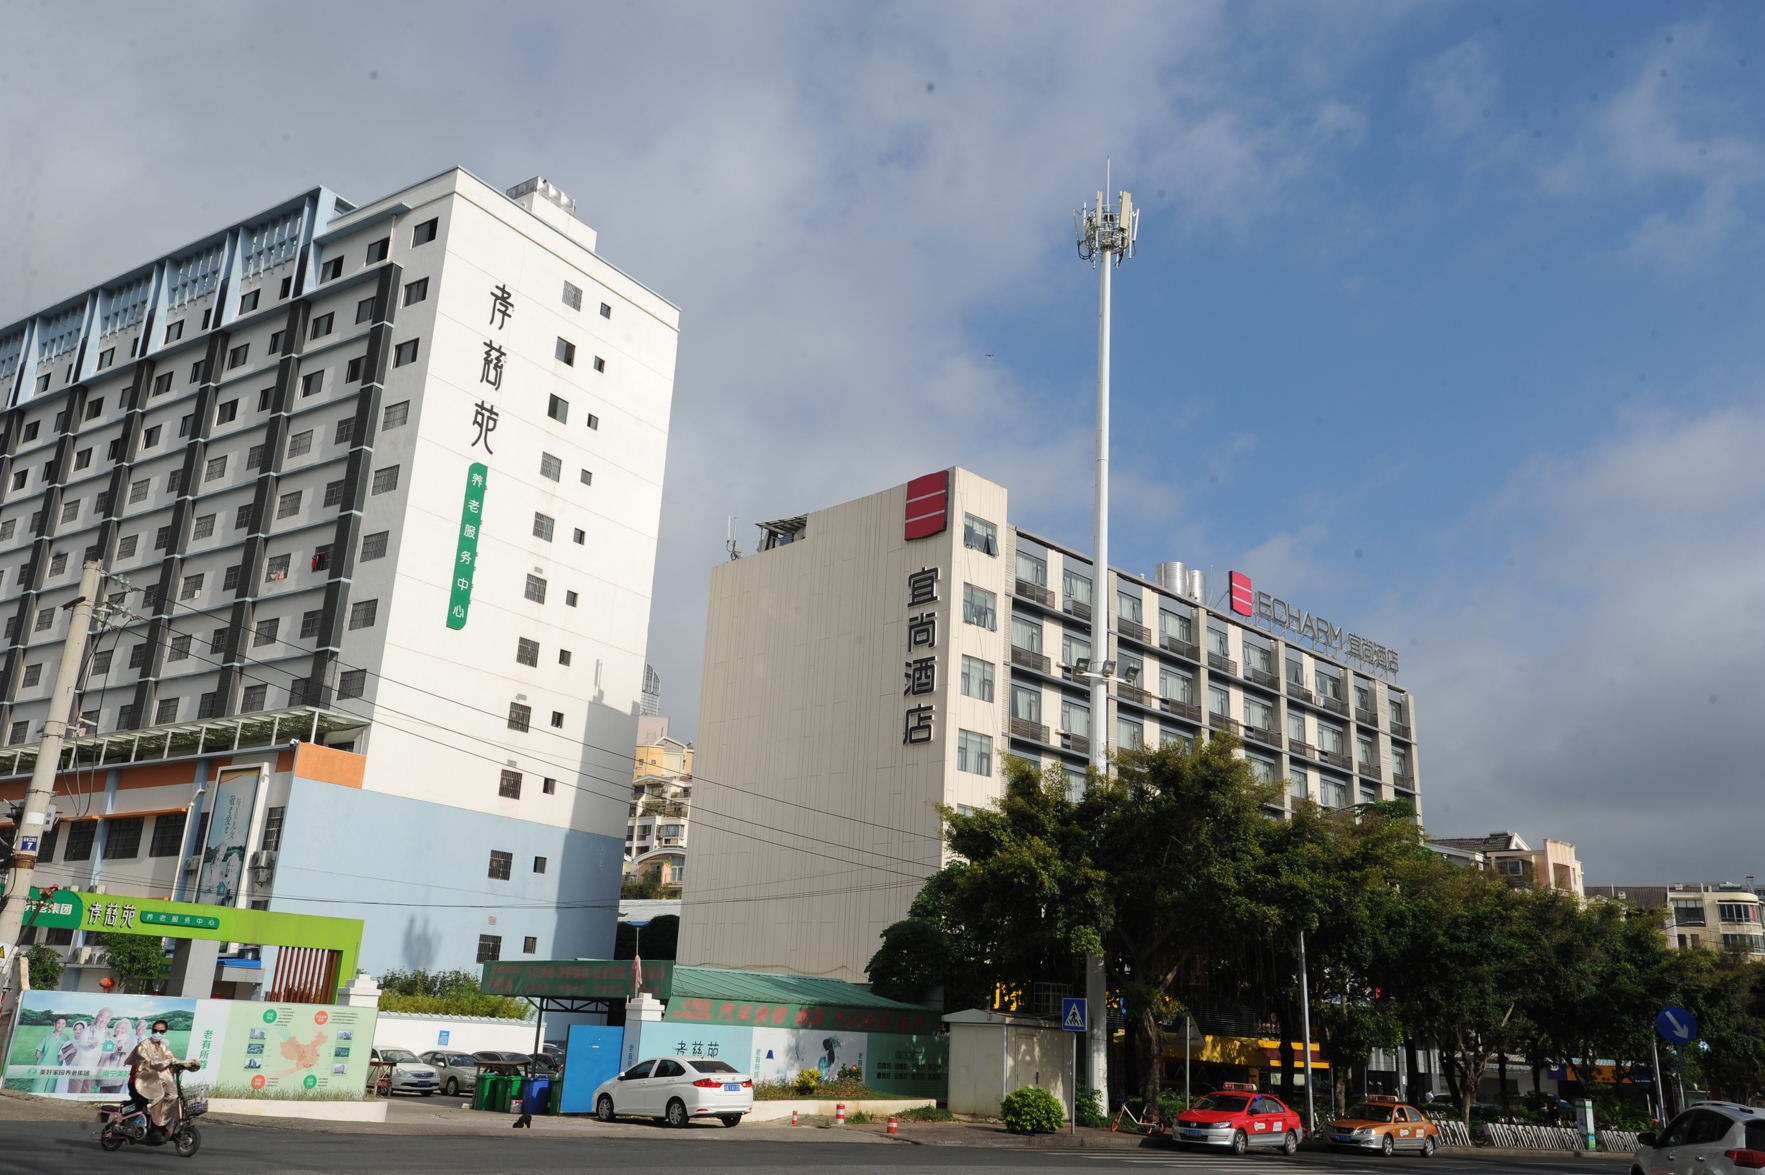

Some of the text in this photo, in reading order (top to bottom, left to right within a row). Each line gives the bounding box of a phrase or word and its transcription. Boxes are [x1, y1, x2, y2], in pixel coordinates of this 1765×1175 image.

[471, 283, 514, 455] 孝慈苑
[452, 473, 484, 619] 养老服务中心
[1255, 590, 1399, 673] ECHARM 宜尚酒店
[903, 566, 941, 746] 宜尚酒店
[27, 842, 33, 850] 7
[88, 902, 136, 928] 孝慈苑
[146, 912, 216, 926] 养老服务中心
[717, 1002, 789, 1024] 汽车快修
[199, 1029, 214, 1070] 老有所尊
[39, 1069, 91, 1077] 美好家园养老集团
